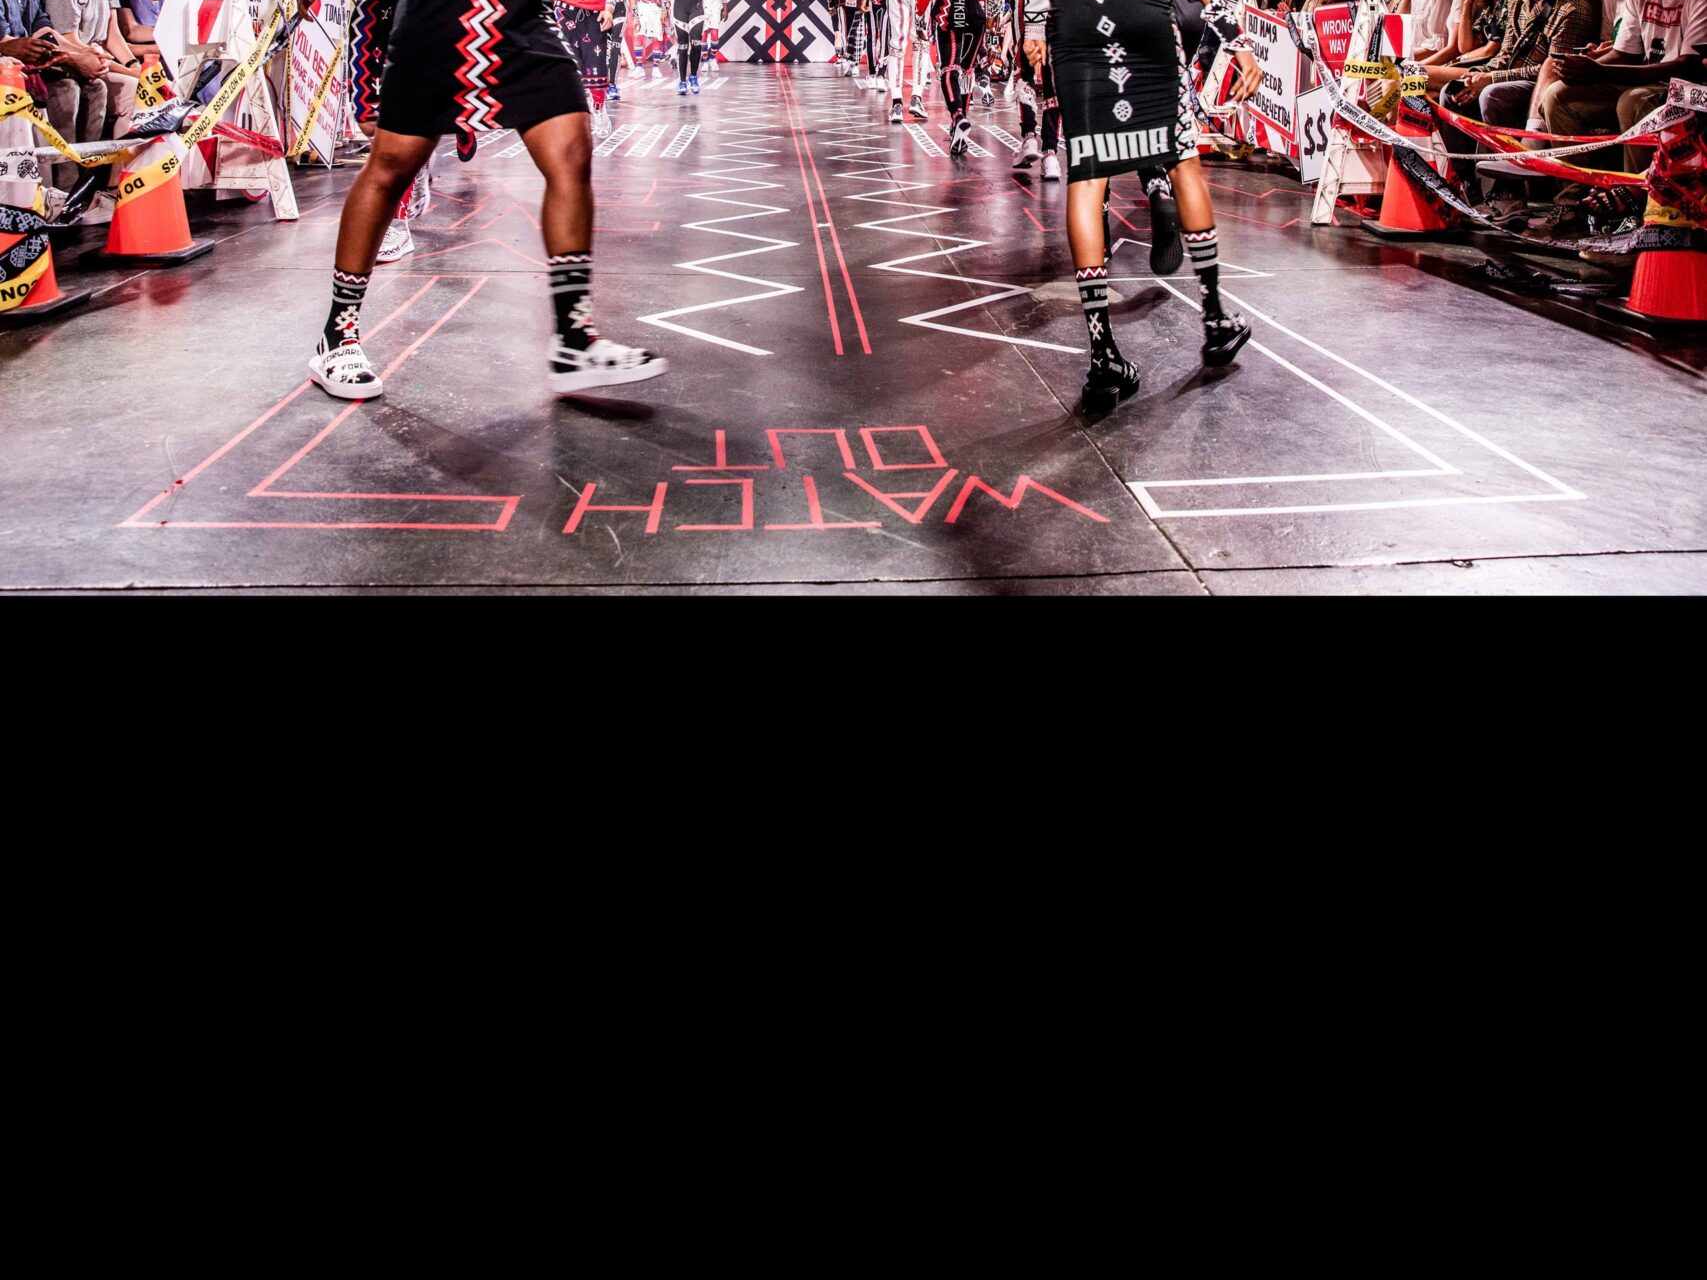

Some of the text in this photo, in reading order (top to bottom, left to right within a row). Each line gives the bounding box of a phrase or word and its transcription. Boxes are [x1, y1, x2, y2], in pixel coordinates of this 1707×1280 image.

[1248, 13, 1279, 45] ВО ИМЯ
[1322, 19, 1354, 36] WRONG
[1329, 38, 1347, 54] WAY
[313, 50, 342, 101] BEER
[212, 88, 229, 114] CROSS
[1070, 126, 1170, 168] PUMA
[671, 426, 948, 471] OUT
[563, 469, 1110, 535] WATCH
